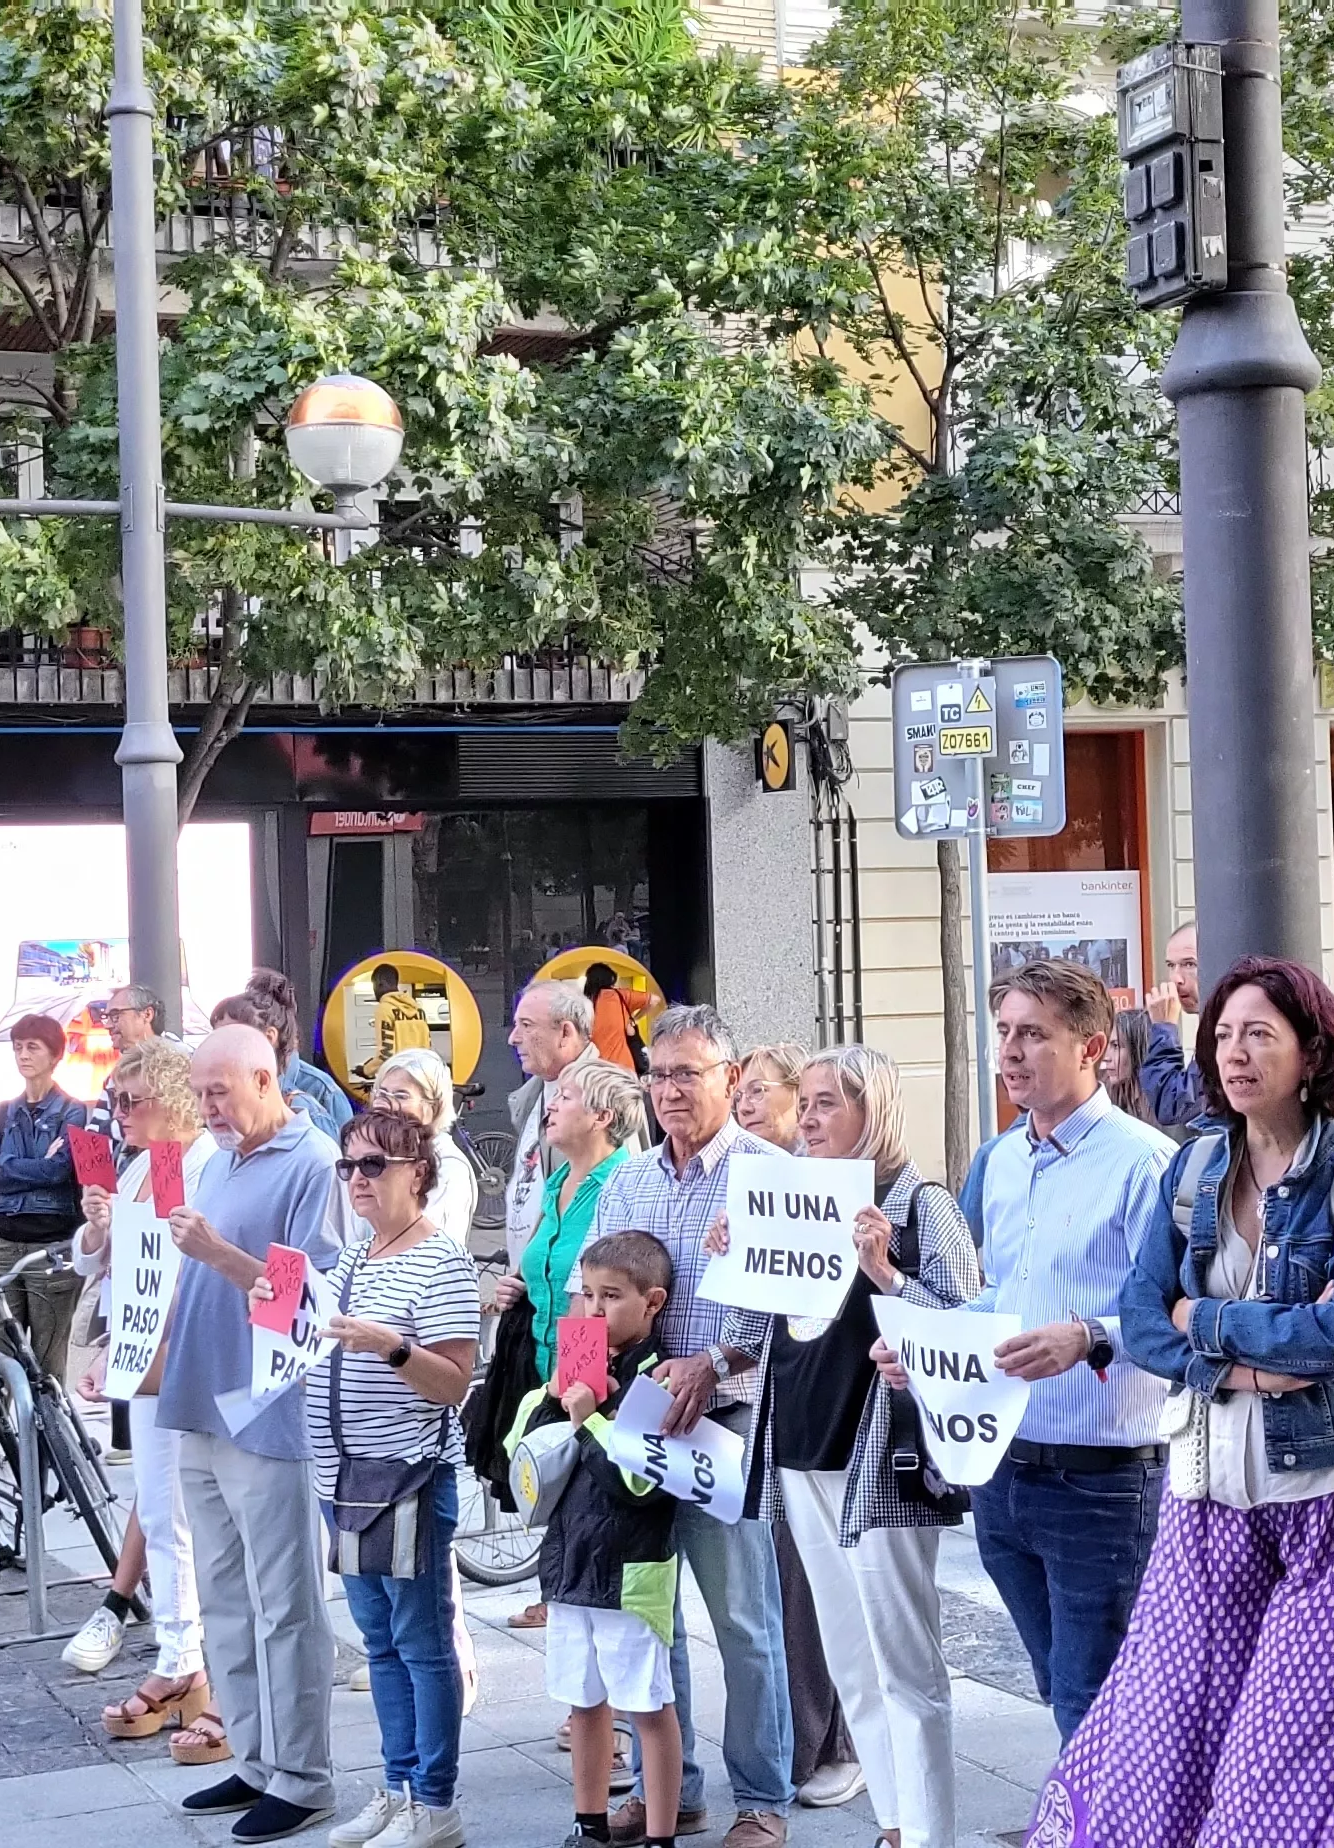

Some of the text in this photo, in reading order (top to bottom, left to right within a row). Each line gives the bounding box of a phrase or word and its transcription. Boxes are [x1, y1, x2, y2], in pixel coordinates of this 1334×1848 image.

[942, 707, 961, 720] TC
[942, 732, 989, 750] Z07661
[747, 1189, 842, 1223] NI UNA
[140, 1231, 162, 1261] NI
[744, 1246, 843, 1282] MENOS
[135, 1267, 163, 1299] UN
[122, 1303, 160, 1336] PASO
[291, 1318, 323, 1356] UN
[111, 1338, 153, 1374] ATRÁS
[271, 1348, 307, 1383] PAS
[901, 1336, 990, 1383] NI UNA
[925, 1409, 998, 1444] NOS
[690, 1449, 716, 1505] NOS
